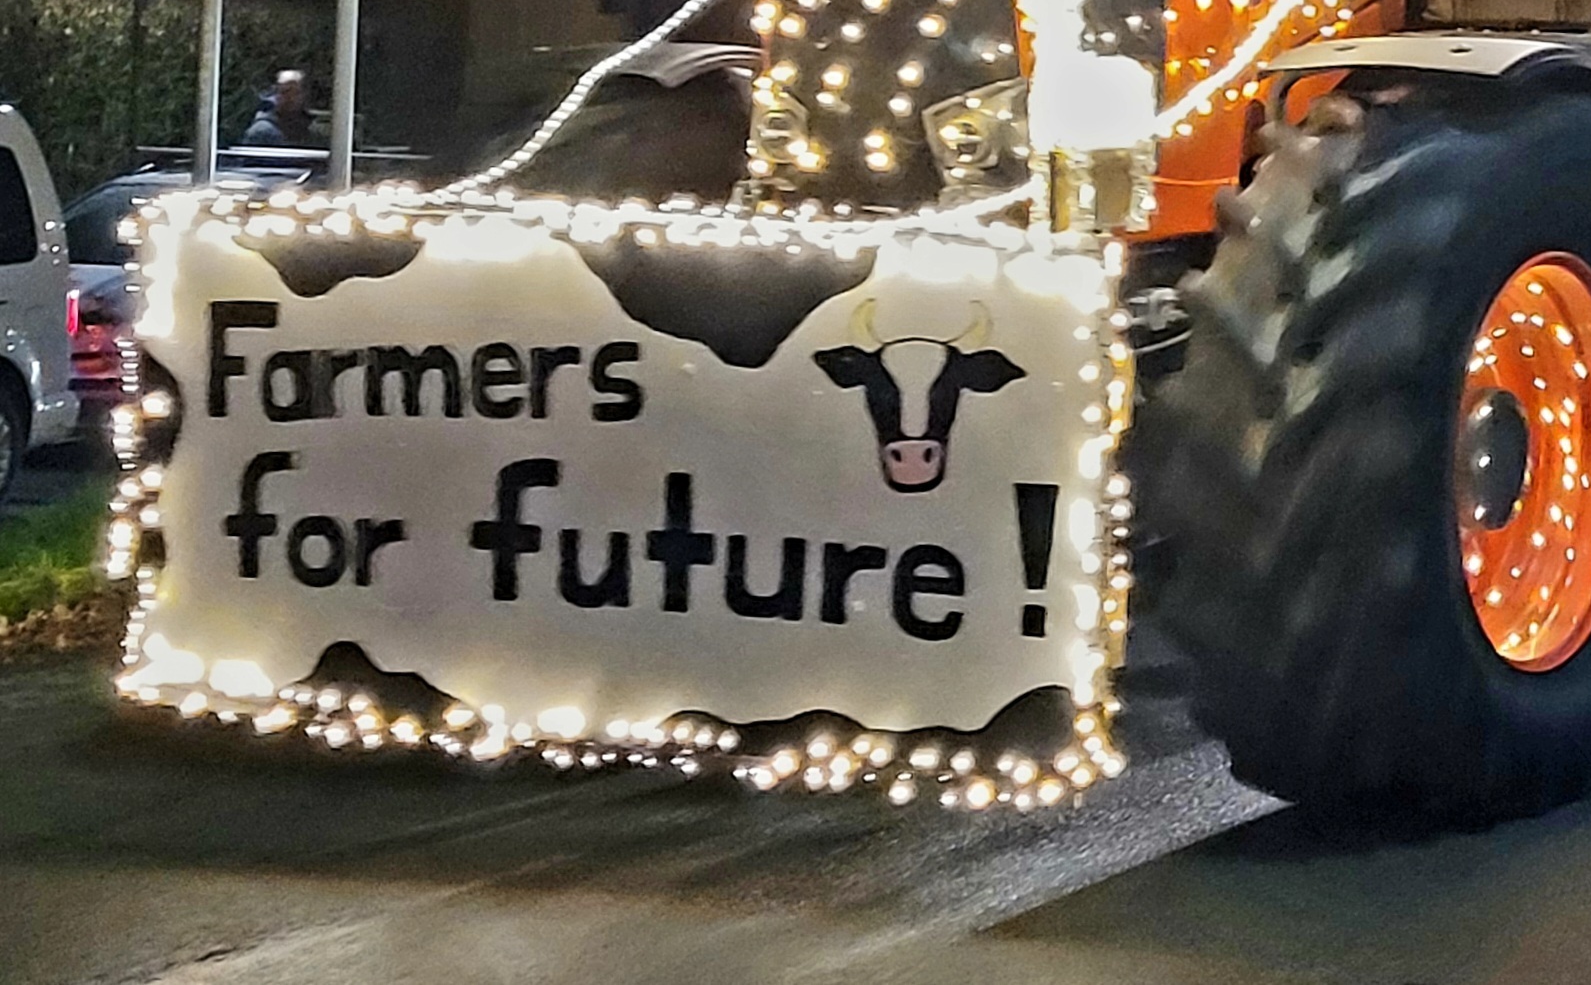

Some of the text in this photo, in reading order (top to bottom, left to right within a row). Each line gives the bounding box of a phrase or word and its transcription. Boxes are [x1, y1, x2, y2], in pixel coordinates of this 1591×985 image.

[209, 300, 644, 422] Farmers
[224, 451, 408, 588] for
[469, 458, 966, 641] future
